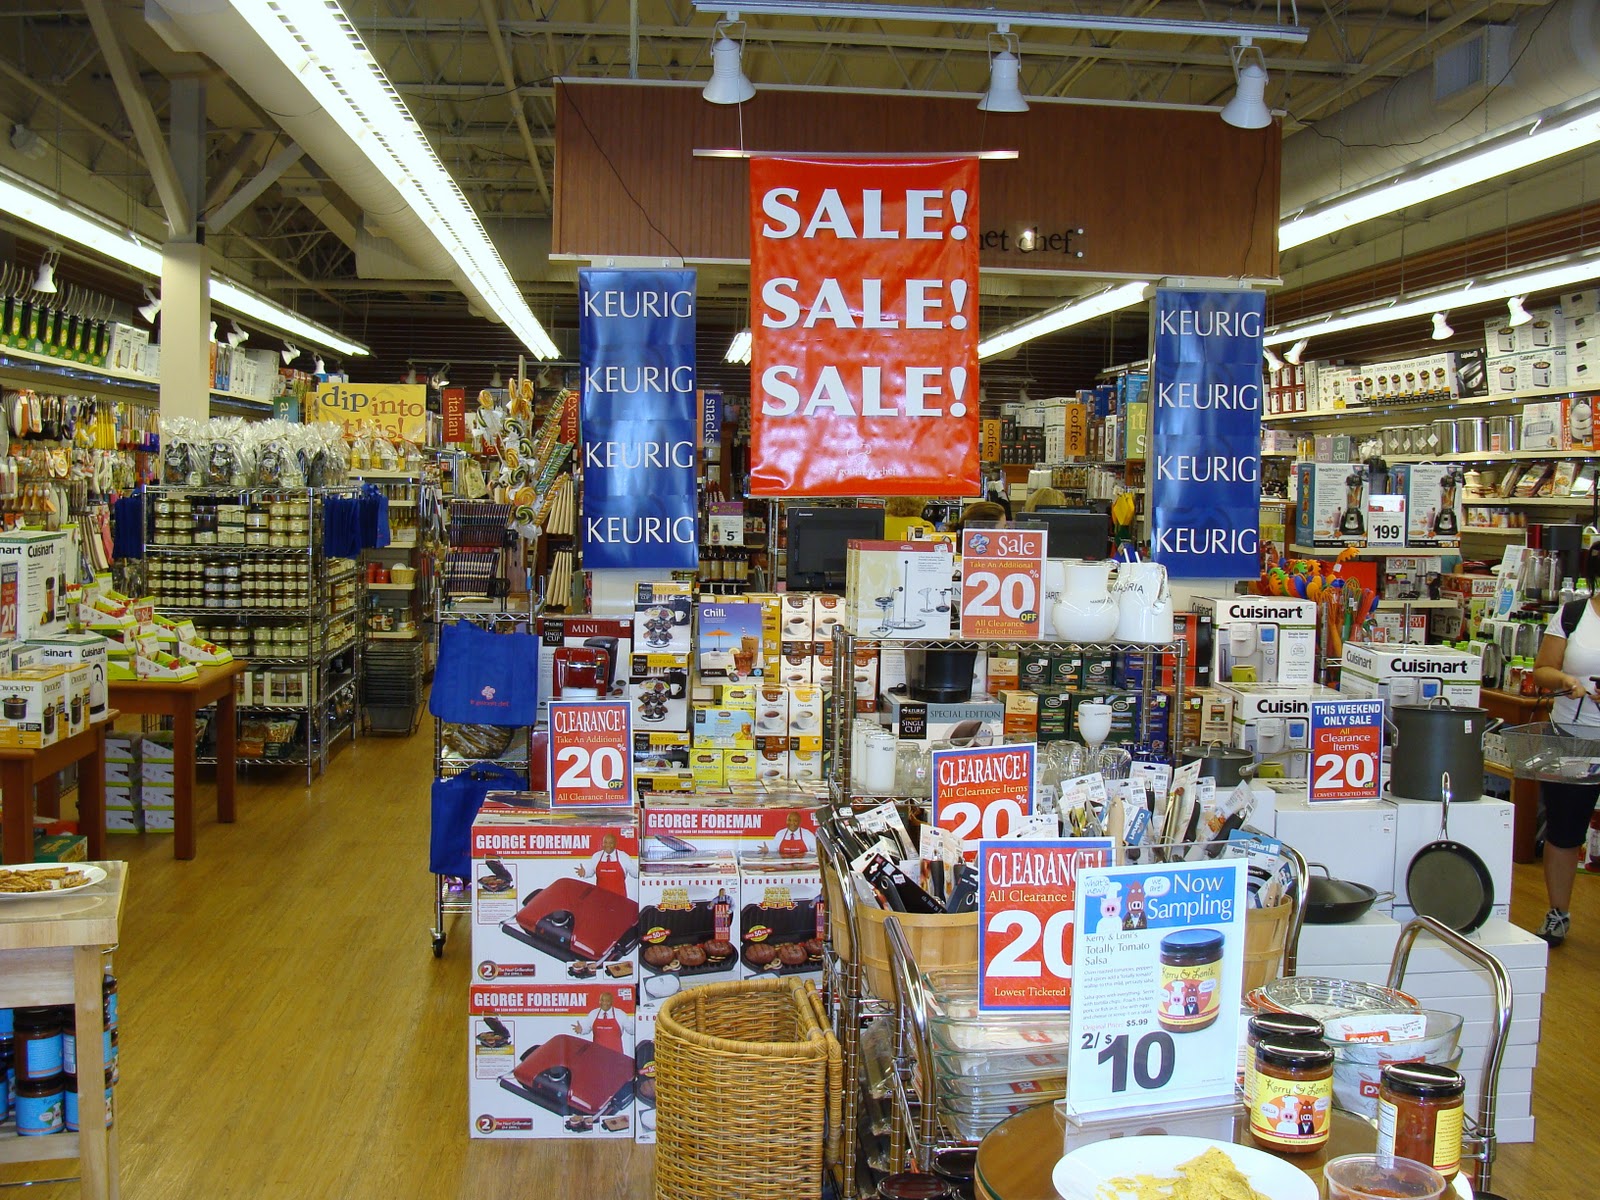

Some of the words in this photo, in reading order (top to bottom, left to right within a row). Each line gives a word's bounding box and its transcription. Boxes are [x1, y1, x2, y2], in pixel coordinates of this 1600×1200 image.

[762, 187, 968, 241] SALE!
[1018, 226, 1074, 254] chef
[584, 290, 692, 319] KEURIG
[762, 277, 968, 331] SALE!
[1160, 310, 1261, 338] KEURIG
[585, 366, 693, 393] KEURIG
[762, 365, 968, 418] SALE!
[1158, 382, 1259, 411] KEURIG
[321, 385, 369, 412] dip
[371, 396, 424, 418] into
[448, 397, 462, 436] italian
[566, 391, 579, 444] tex-mex
[705, 398, 719, 444] snacks
[1070, 407, 1082, 451] coffee
[987, 422, 997, 458] coffee
[585, 441, 694, 469] KEURIG
[1157, 455, 1257, 482] KEURIG
[587, 516, 695, 544] KEURIG
[998, 534, 1035, 557] Sale
[1156, 528, 1258, 555] KEURIG
[28, 542, 54, 559] Cuisinart
[970, 561, 986, 569] Take
[999, 561, 1034, 569] Additional
[703, 608, 726, 617] Chill.
[1192, 602, 1213, 616] Cuisinart
[1229, 604, 1303, 619] Cuisinart
[975, 620, 986, 628] All
[988, 620, 1025, 628] Clearance
[1021, 612, 1037, 622] OFF
[571, 624, 598, 633] MINI
[44, 648, 72, 658] isinart
[81, 646, 105, 658] Cuisinart
[1346, 650, 1372, 670] Cuisinart
[1390, 658, 1468, 674] Cuisinart
[1257, 699, 1309, 713] Cuisin
[1315, 704, 1336, 715] THIS
[1337, 703, 1381, 715] WEEKEND
[555, 709, 626, 734] CLEARANCE!
[930, 710, 962, 719] SPECIAL
[965, 710, 1001, 719] EDITION
[1323, 716, 1347, 726] ONLY
[1350, 715, 1372, 725] SALE
[556, 736, 573, 744] Take
[587, 735, 623, 744] Additional
[1320, 733, 1371, 743] Clearance
[1333, 743, 1359, 751] Items
[939, 752, 1028, 787] CLEARANCE!
[609, 781, 624, 789] OFF
[939, 789, 953, 798] All
[956, 785, 1001, 796] Clearance
[1003, 785, 1028, 794] Items
[1364, 781, 1374, 789] off
[557, 793, 570, 801] All
[572, 793, 603, 801] Clearance
[605, 792, 625, 800] Items
[648, 813, 698, 828] GEORGE
[701, 814, 762, 829] FOREMAN
[476, 834, 526, 849] GEORGE
[529, 834, 591, 849] FOREMAN
[1173, 873, 1224, 894] Now
[988, 890, 1007, 902] All
[1009, 888, 1067, 902] Clearance
[1147, 893, 1233, 923] Sampling
[1086, 935, 1105, 943] Kerry
[1116, 931, 1138, 940] Loni's
[1085, 943, 1115, 955] Totally
[1118, 942, 1150, 952] Tomato
[1084, 955, 1108, 967] Salsa
[483, 964, 492, 976] 2
[474, 992, 524, 1007] GEORGE
[527, 992, 588, 1007] FOREMAN
[994, 987, 1026, 998] Lowest
[1027, 986, 1066, 998] Ticketed
[1126, 1018, 1148, 1027] $5.99
[1265, 1079, 1291, 1094] Kerry
[481, 1118, 490, 1130] 2
